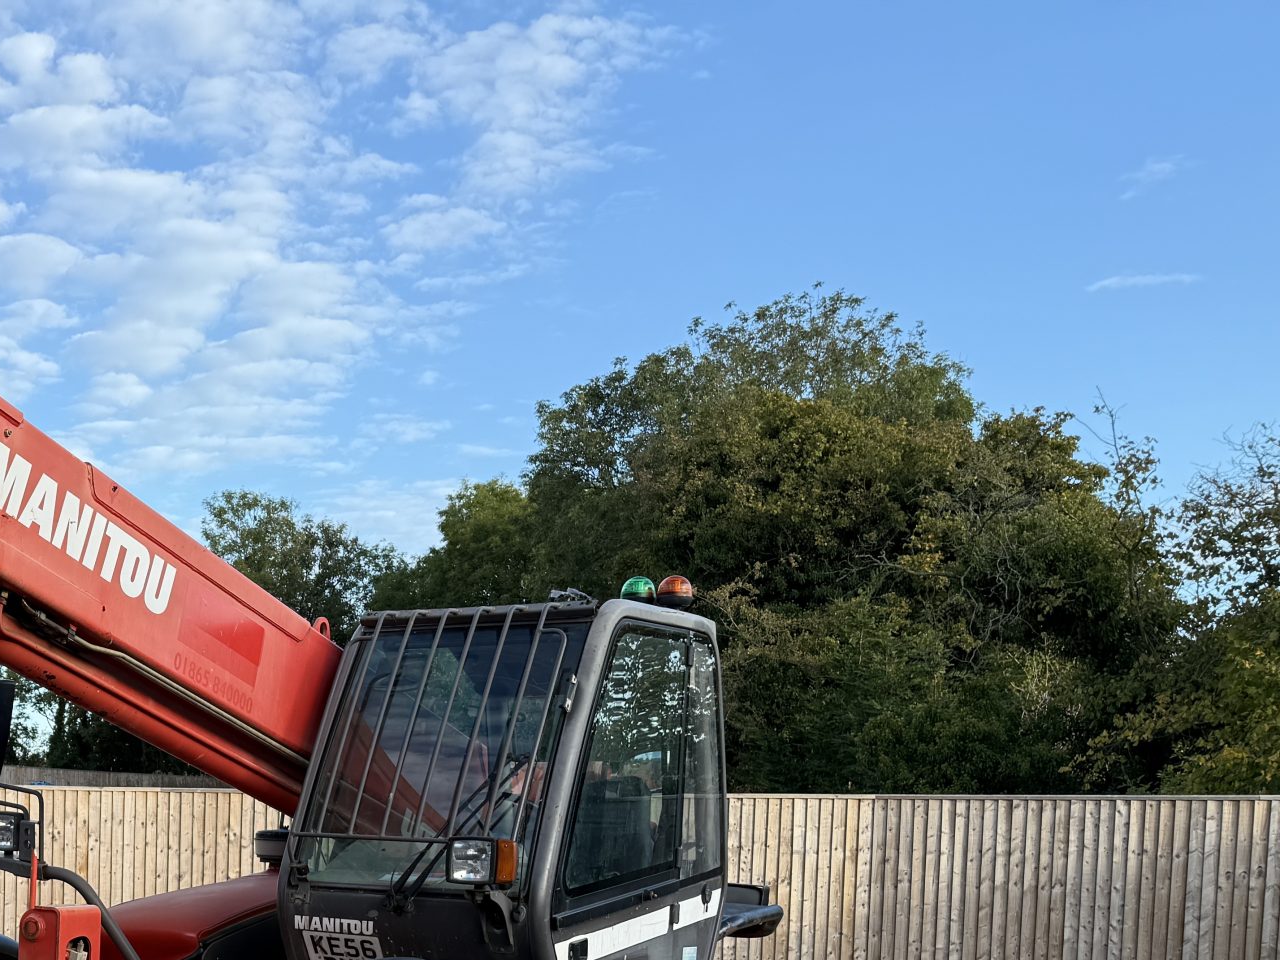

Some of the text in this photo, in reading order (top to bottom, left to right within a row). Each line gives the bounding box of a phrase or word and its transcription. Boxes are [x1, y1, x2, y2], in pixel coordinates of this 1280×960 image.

[174, 652, 253, 714] 01865 840000
[294, 914, 374, 936] MANITOU
[310, 934, 377, 960] KE56
